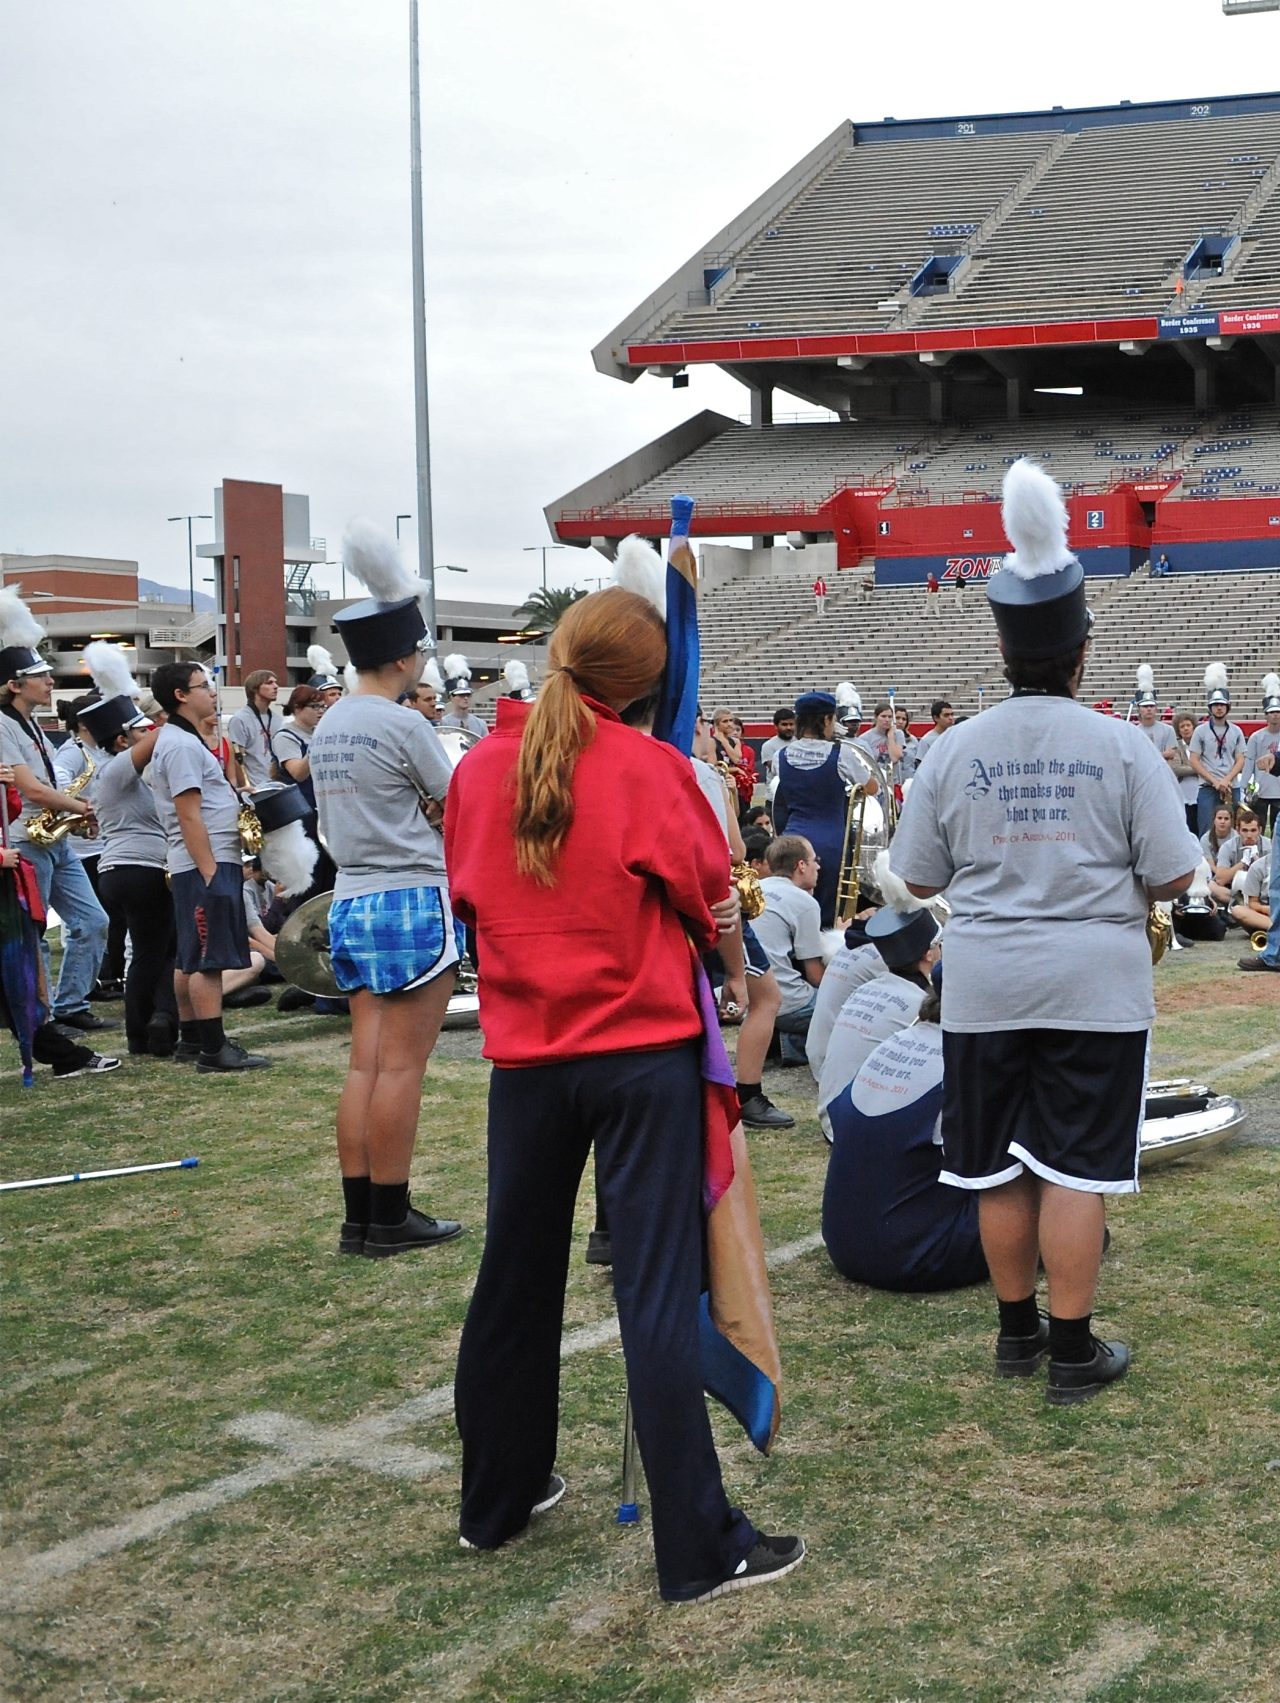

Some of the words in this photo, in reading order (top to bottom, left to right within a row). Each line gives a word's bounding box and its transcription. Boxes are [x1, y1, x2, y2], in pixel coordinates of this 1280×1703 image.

[1191, 105, 1210, 115] 202
[957, 122, 975, 133] 201
[1160, 318, 1181, 327] Border
[1182, 317, 1215, 325] Conference
[1223, 315, 1244, 323] Border
[1245, 313, 1279, 321] Conference
[1091, 512, 1099, 523] 2
[881, 521, 887, 531] 1
[941, 557, 1003, 579] ZONA
[964, 758, 1004, 800] And
[1006, 758, 1020, 777] it's
[1023, 758, 1045, 776] only
[1048, 758, 1065, 776] the
[1067, 759, 1104, 780] giving
[1020, 783, 1052, 799] makes
[1055, 784, 1075, 800] you
[1048, 807, 1071, 821] are.
[1055, 831, 1076, 842] 2011
